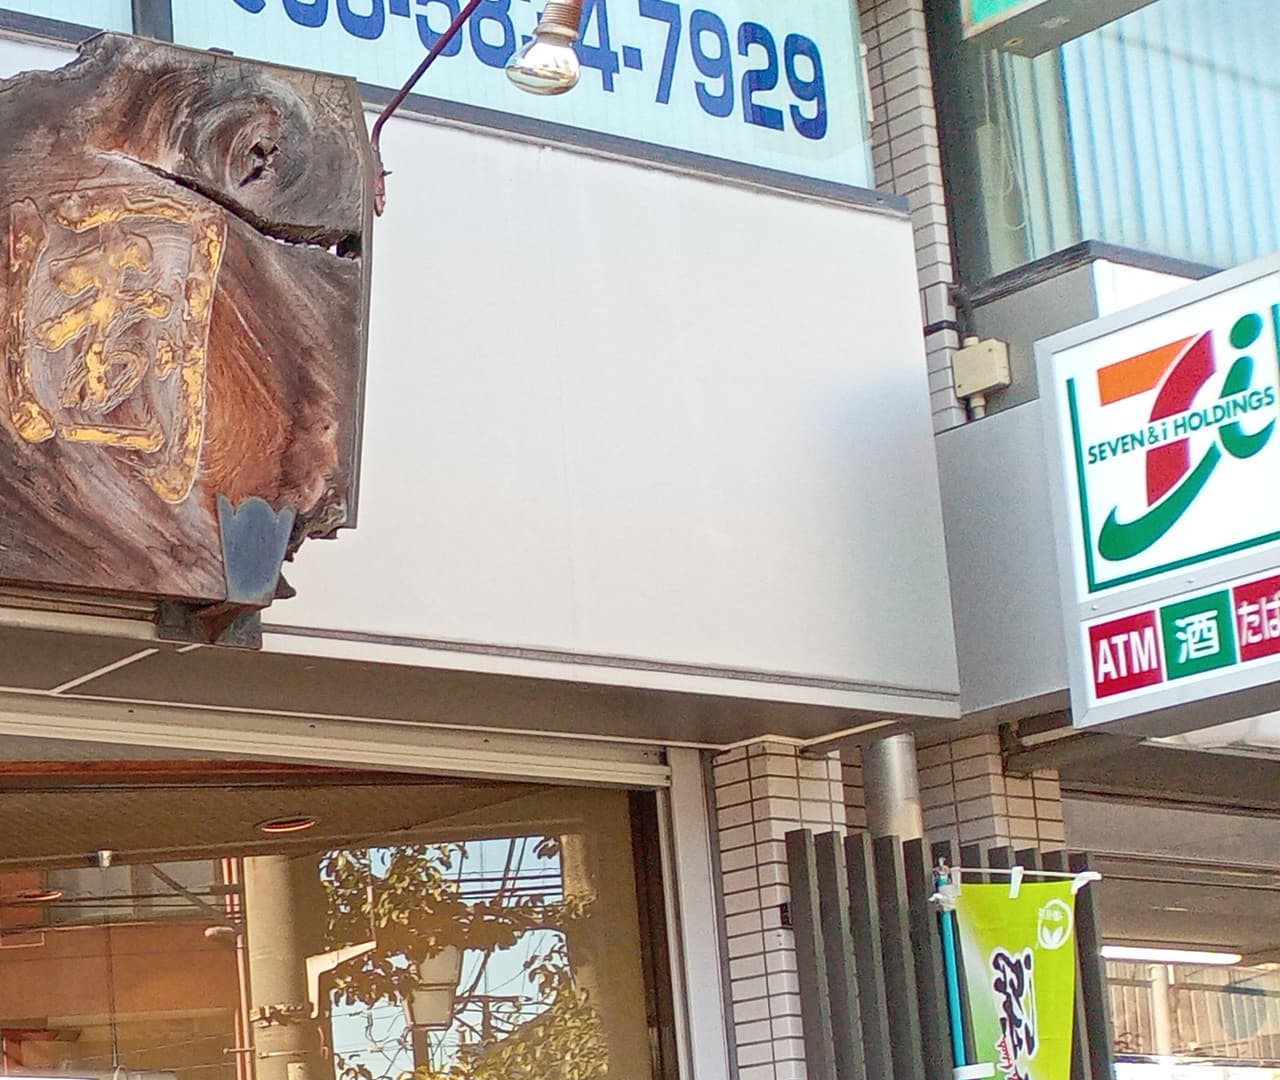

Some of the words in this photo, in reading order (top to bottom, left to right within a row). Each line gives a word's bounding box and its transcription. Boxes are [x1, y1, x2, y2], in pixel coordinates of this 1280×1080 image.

[1173, 385, 1276, 436] HOLDINGS
[1096, 625, 1159, 684] ATM
[1174, 608, 1220, 664] 酒
